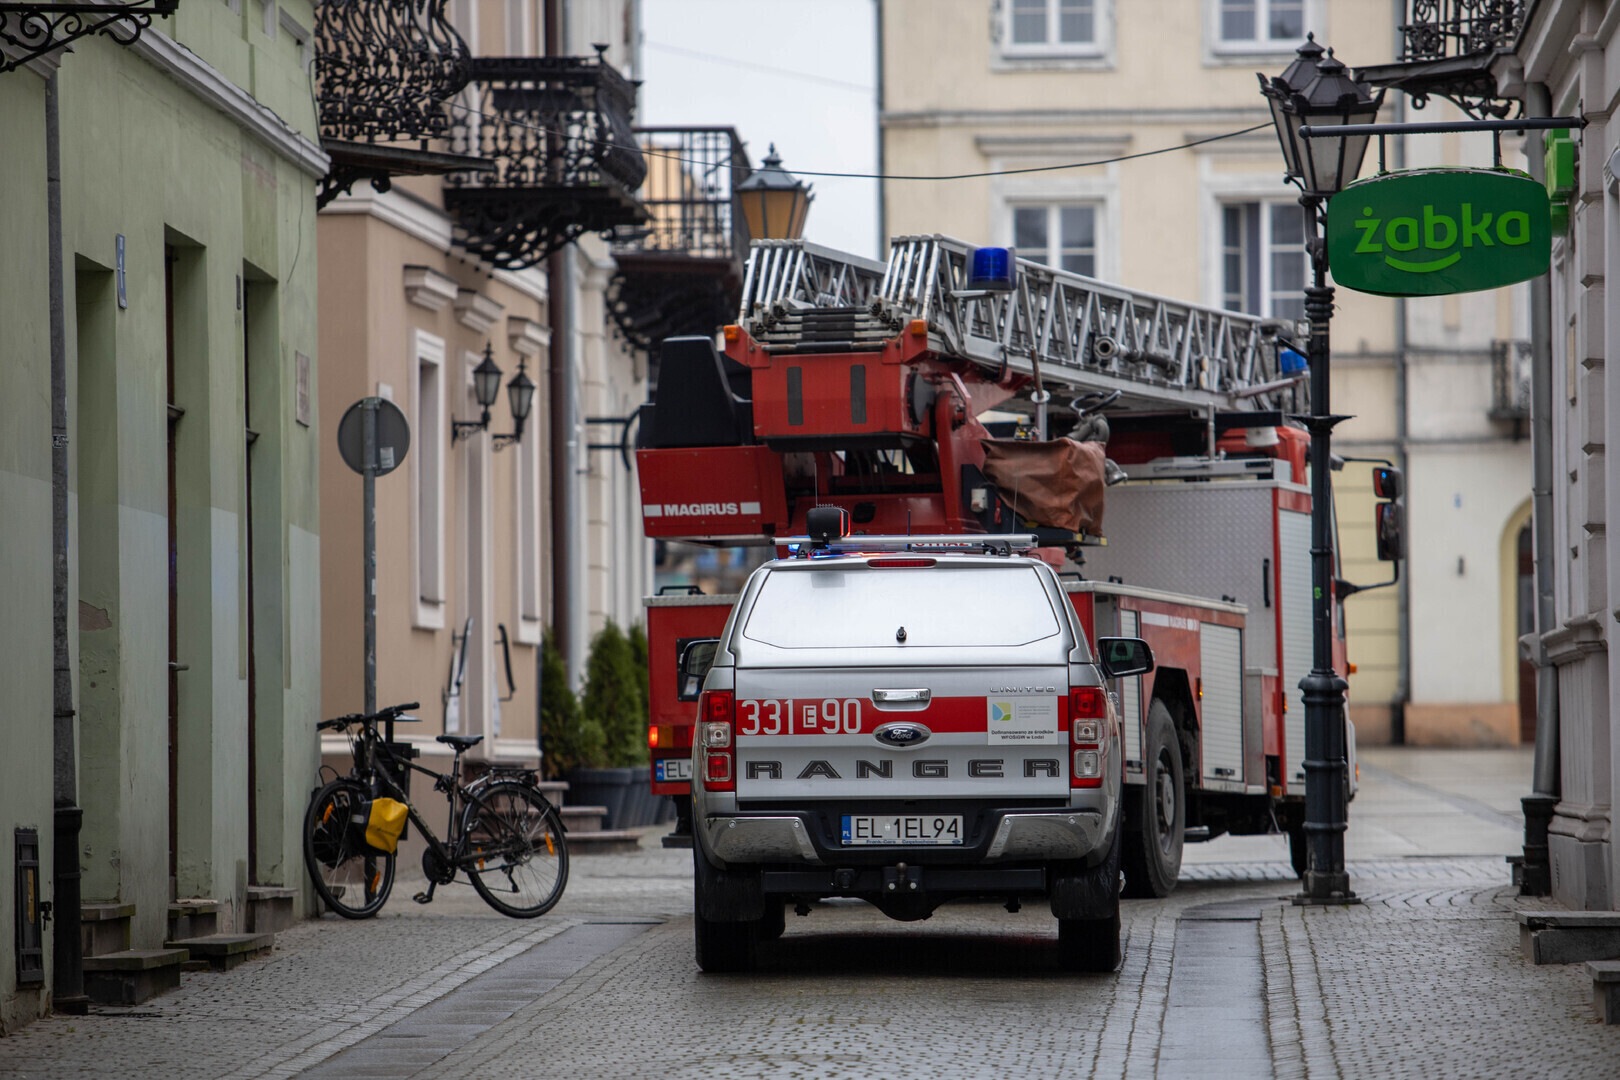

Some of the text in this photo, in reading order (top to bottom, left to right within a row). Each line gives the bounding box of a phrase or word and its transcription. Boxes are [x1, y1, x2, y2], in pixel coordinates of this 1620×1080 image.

[1354, 203, 1531, 253] żabka
[664, 503, 738, 516] MAGIRUS
[890, 729, 913, 740] Ford
[666, 762, 687, 777] EL
[746, 759, 1060, 779] RANGER
[856, 818, 958, 838] EL 1EL94
